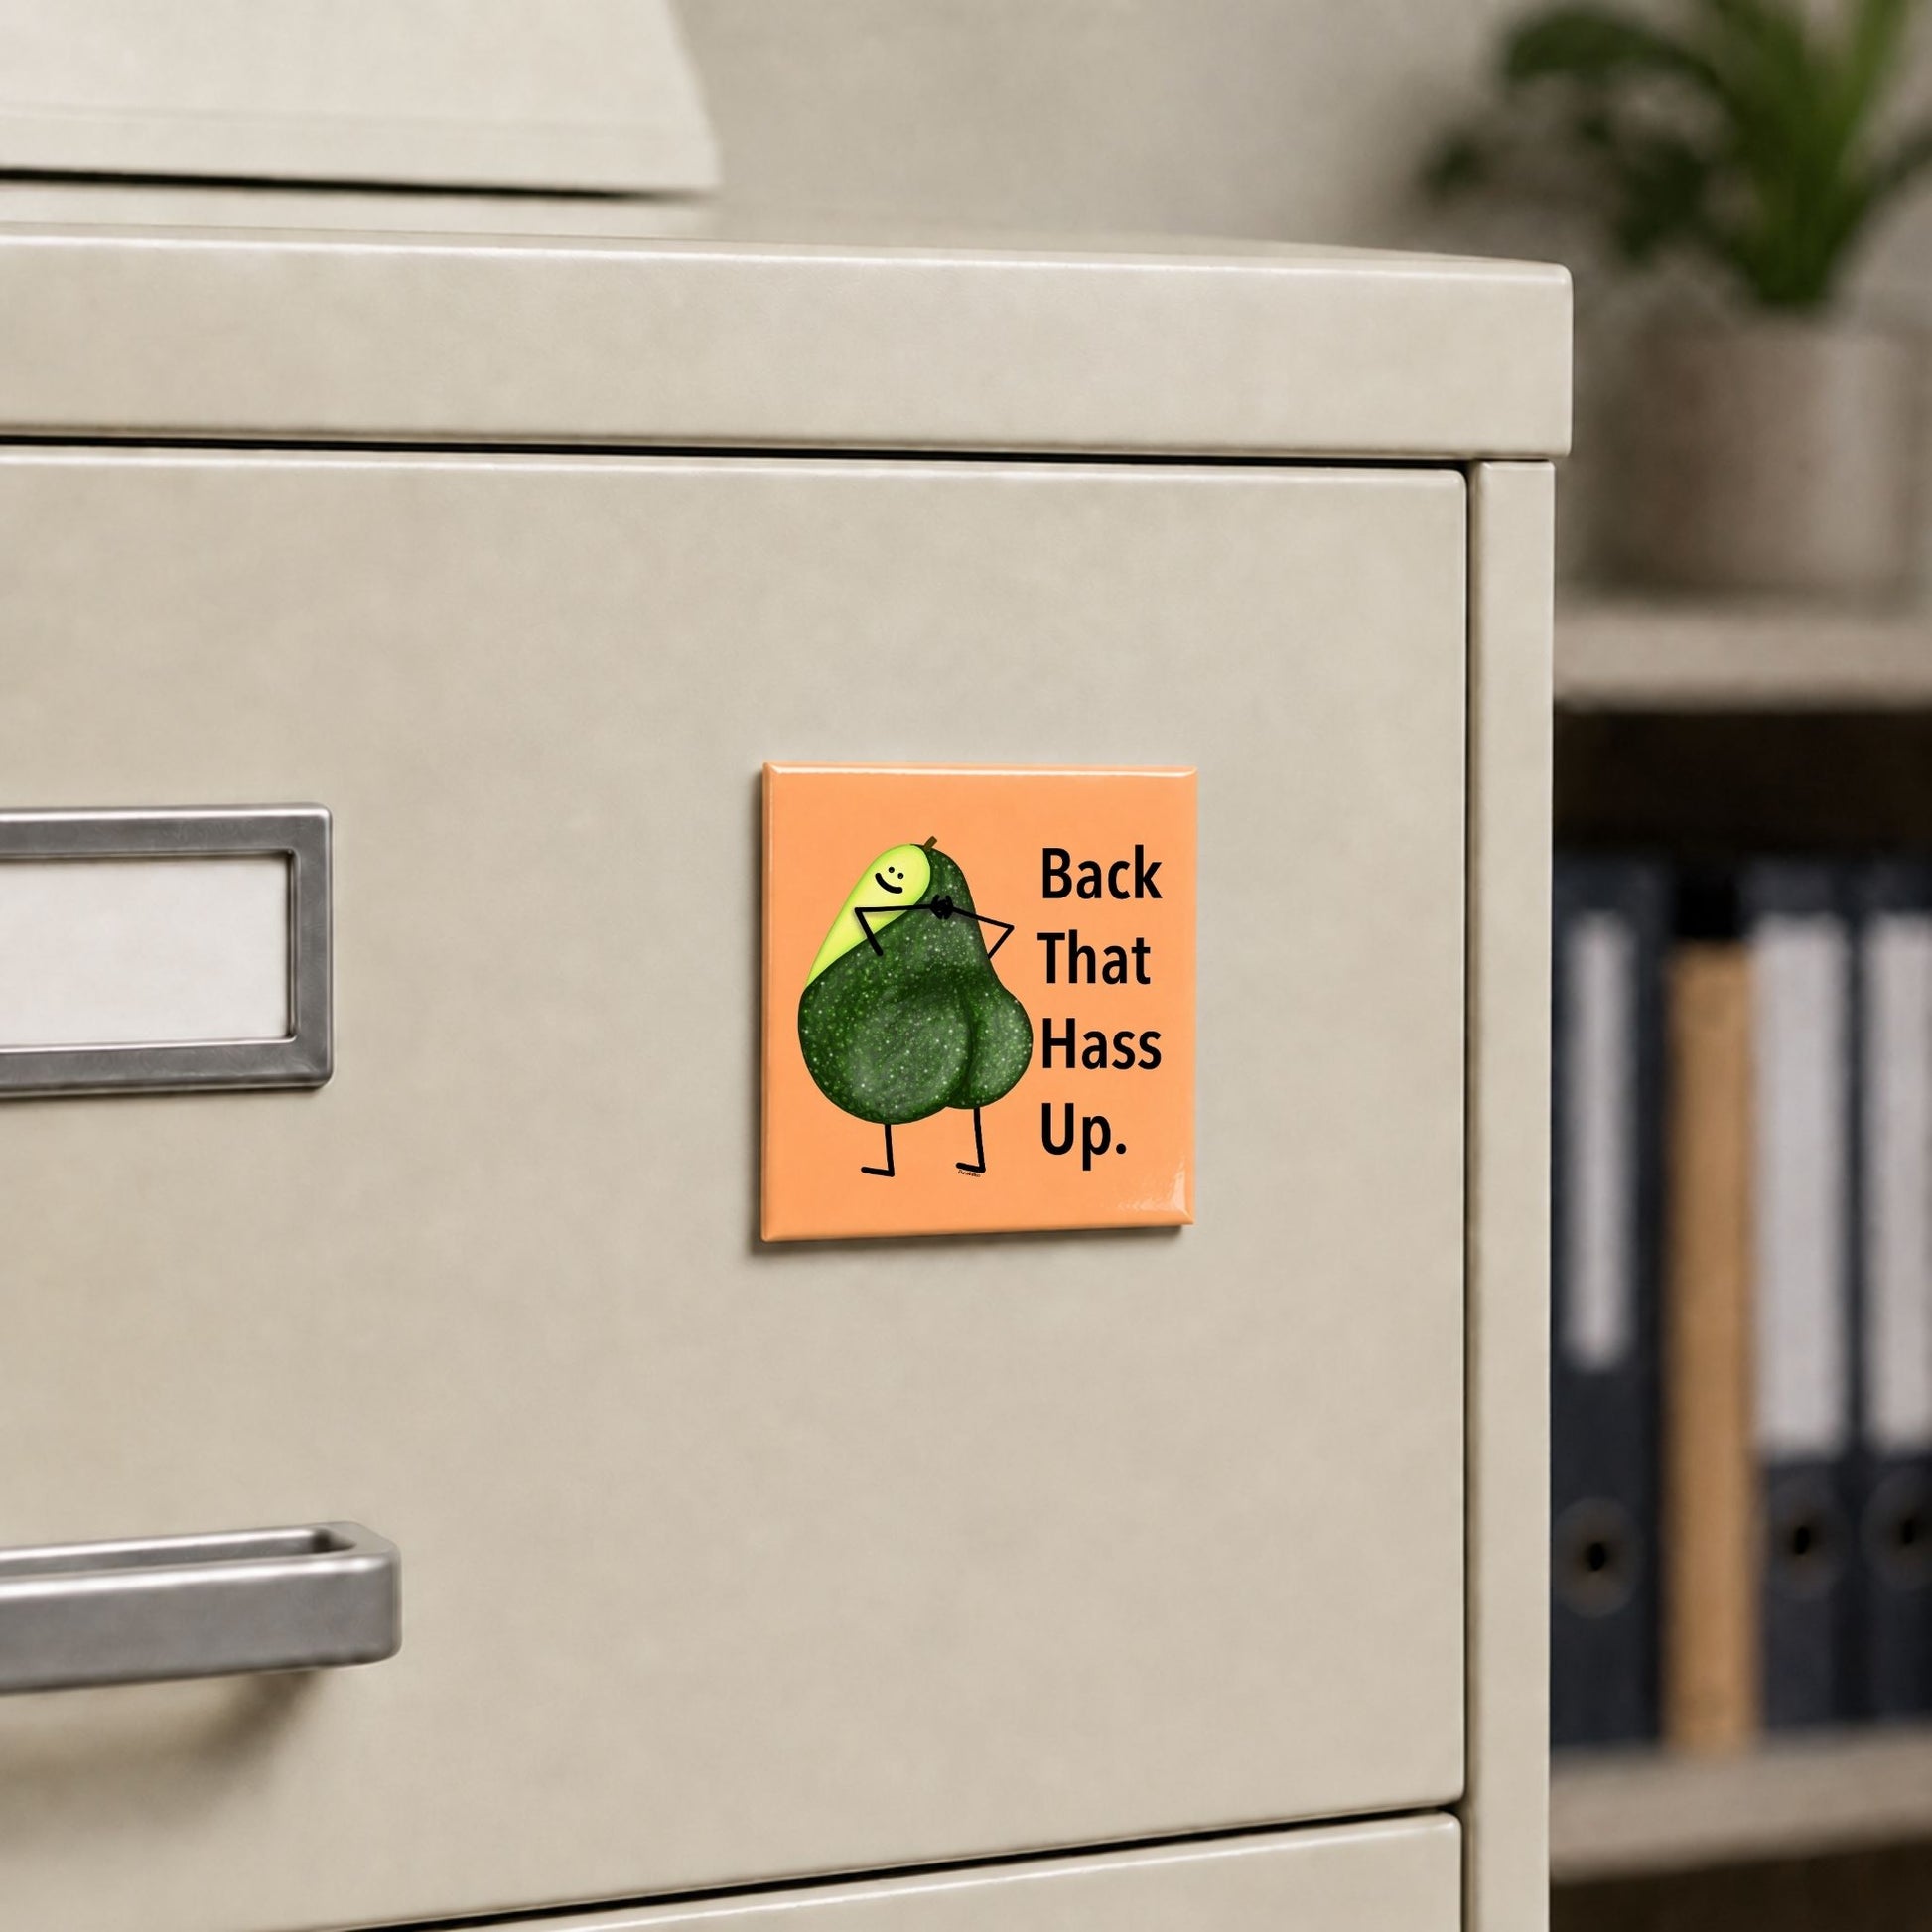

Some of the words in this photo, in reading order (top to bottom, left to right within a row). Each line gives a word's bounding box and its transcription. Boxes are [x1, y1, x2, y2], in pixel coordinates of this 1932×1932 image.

[1042, 844, 1163, 900] Back
[1036, 929, 1151, 985] That
[1042, 1017, 1162, 1070] Hass
[1041, 1102, 1127, 1172] Up.
